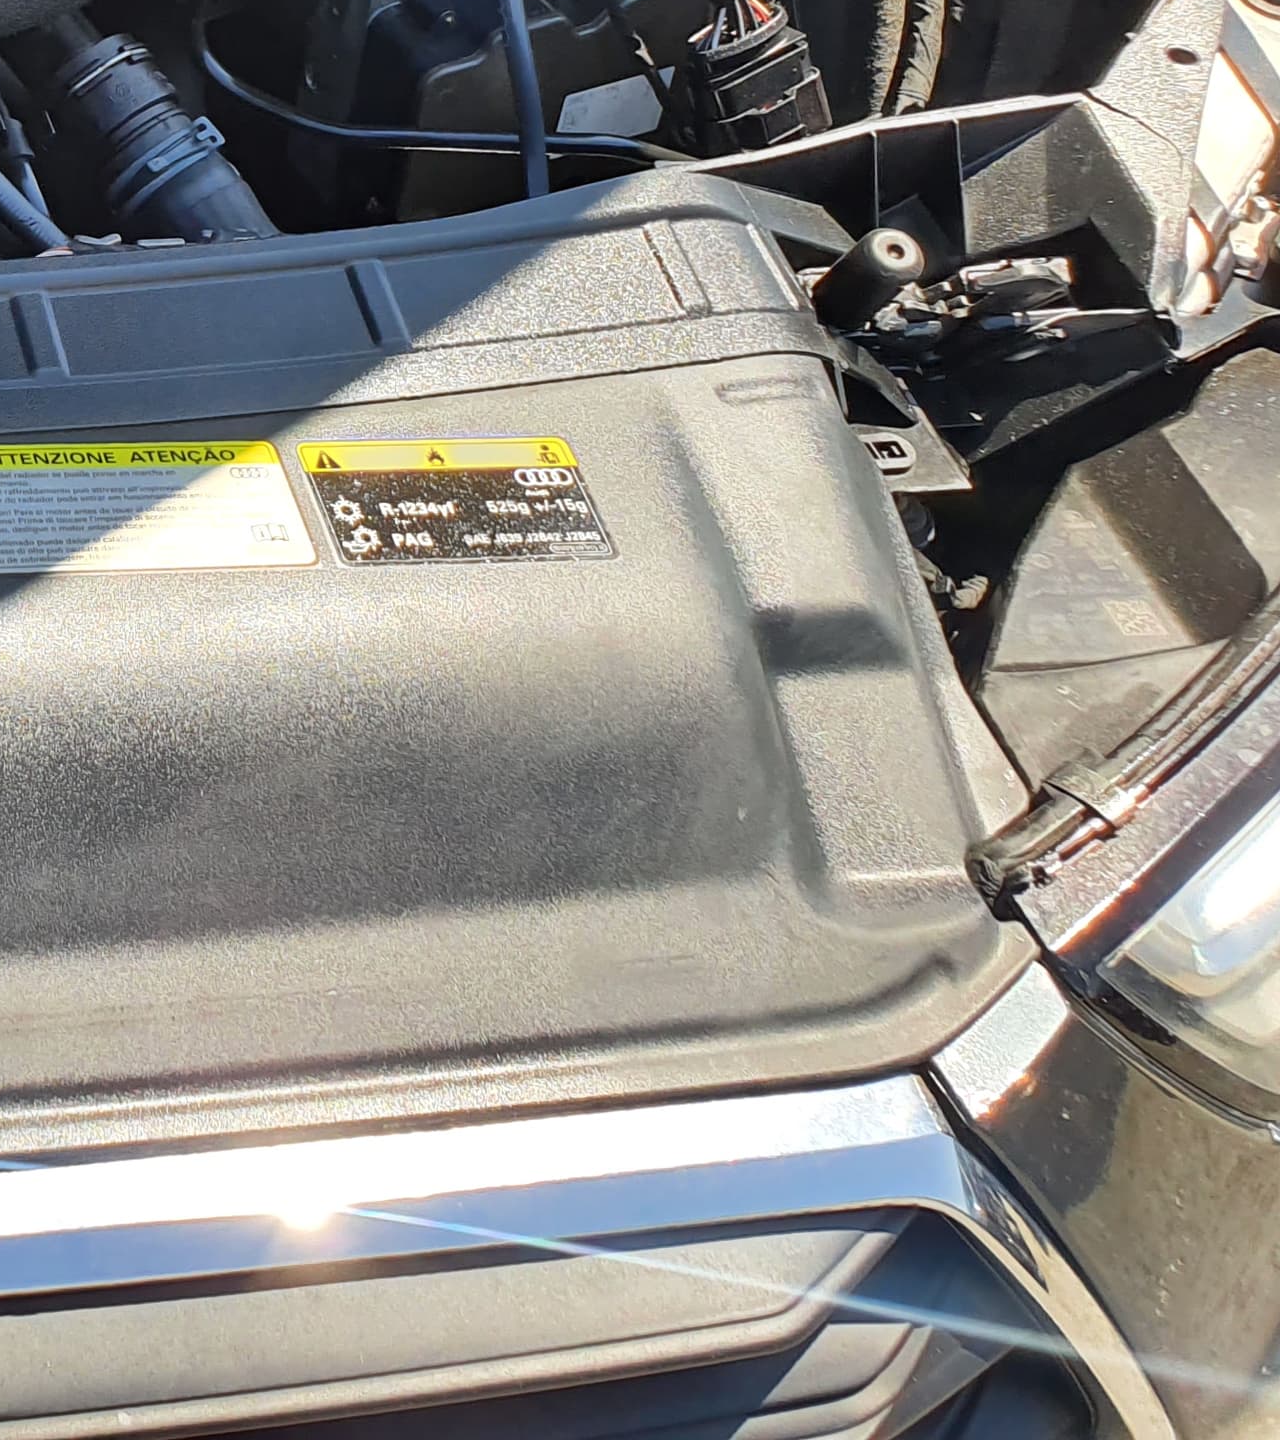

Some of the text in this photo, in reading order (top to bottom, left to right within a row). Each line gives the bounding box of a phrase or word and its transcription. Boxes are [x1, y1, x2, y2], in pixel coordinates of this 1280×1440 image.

[130, 448, 236, 464] ATENÇÃO
[378, 501, 455, 518] R-1234yf
[486, 500, 530, 515] 525g
[391, 532, 434, 547] PAG
